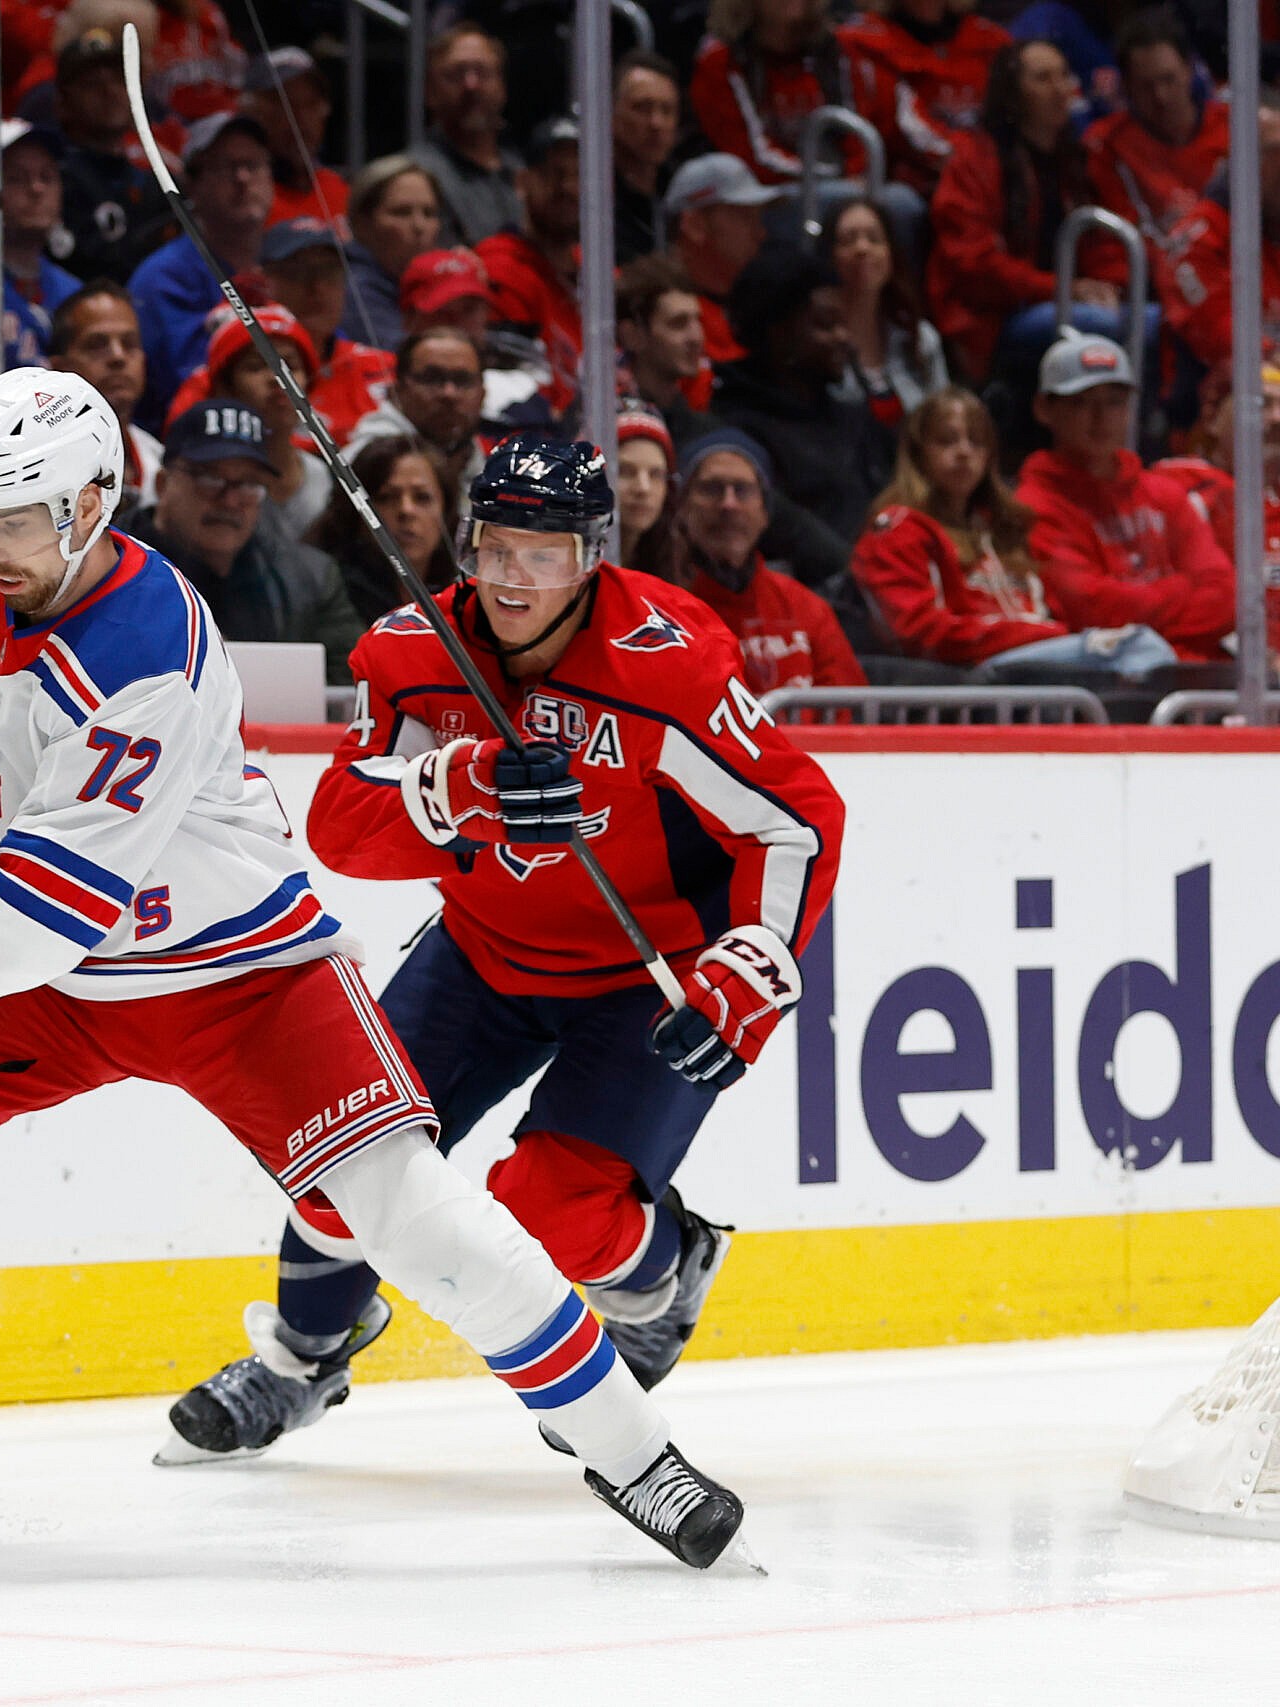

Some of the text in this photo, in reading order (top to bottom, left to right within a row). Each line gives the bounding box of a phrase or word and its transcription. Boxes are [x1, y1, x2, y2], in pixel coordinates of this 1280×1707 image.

[222, 283, 252, 323] CCM
[32, 393, 72, 424] Benjamin
[46, 405, 74, 428] Moore
[515, 456, 546, 480] 74
[344, 680, 376, 747] 4
[532, 697, 585, 746] 50
[708, 675, 776, 762] 74
[582, 712, 626, 769] A
[76, 725, 162, 814] 72
[716, 937, 792, 997] CM
